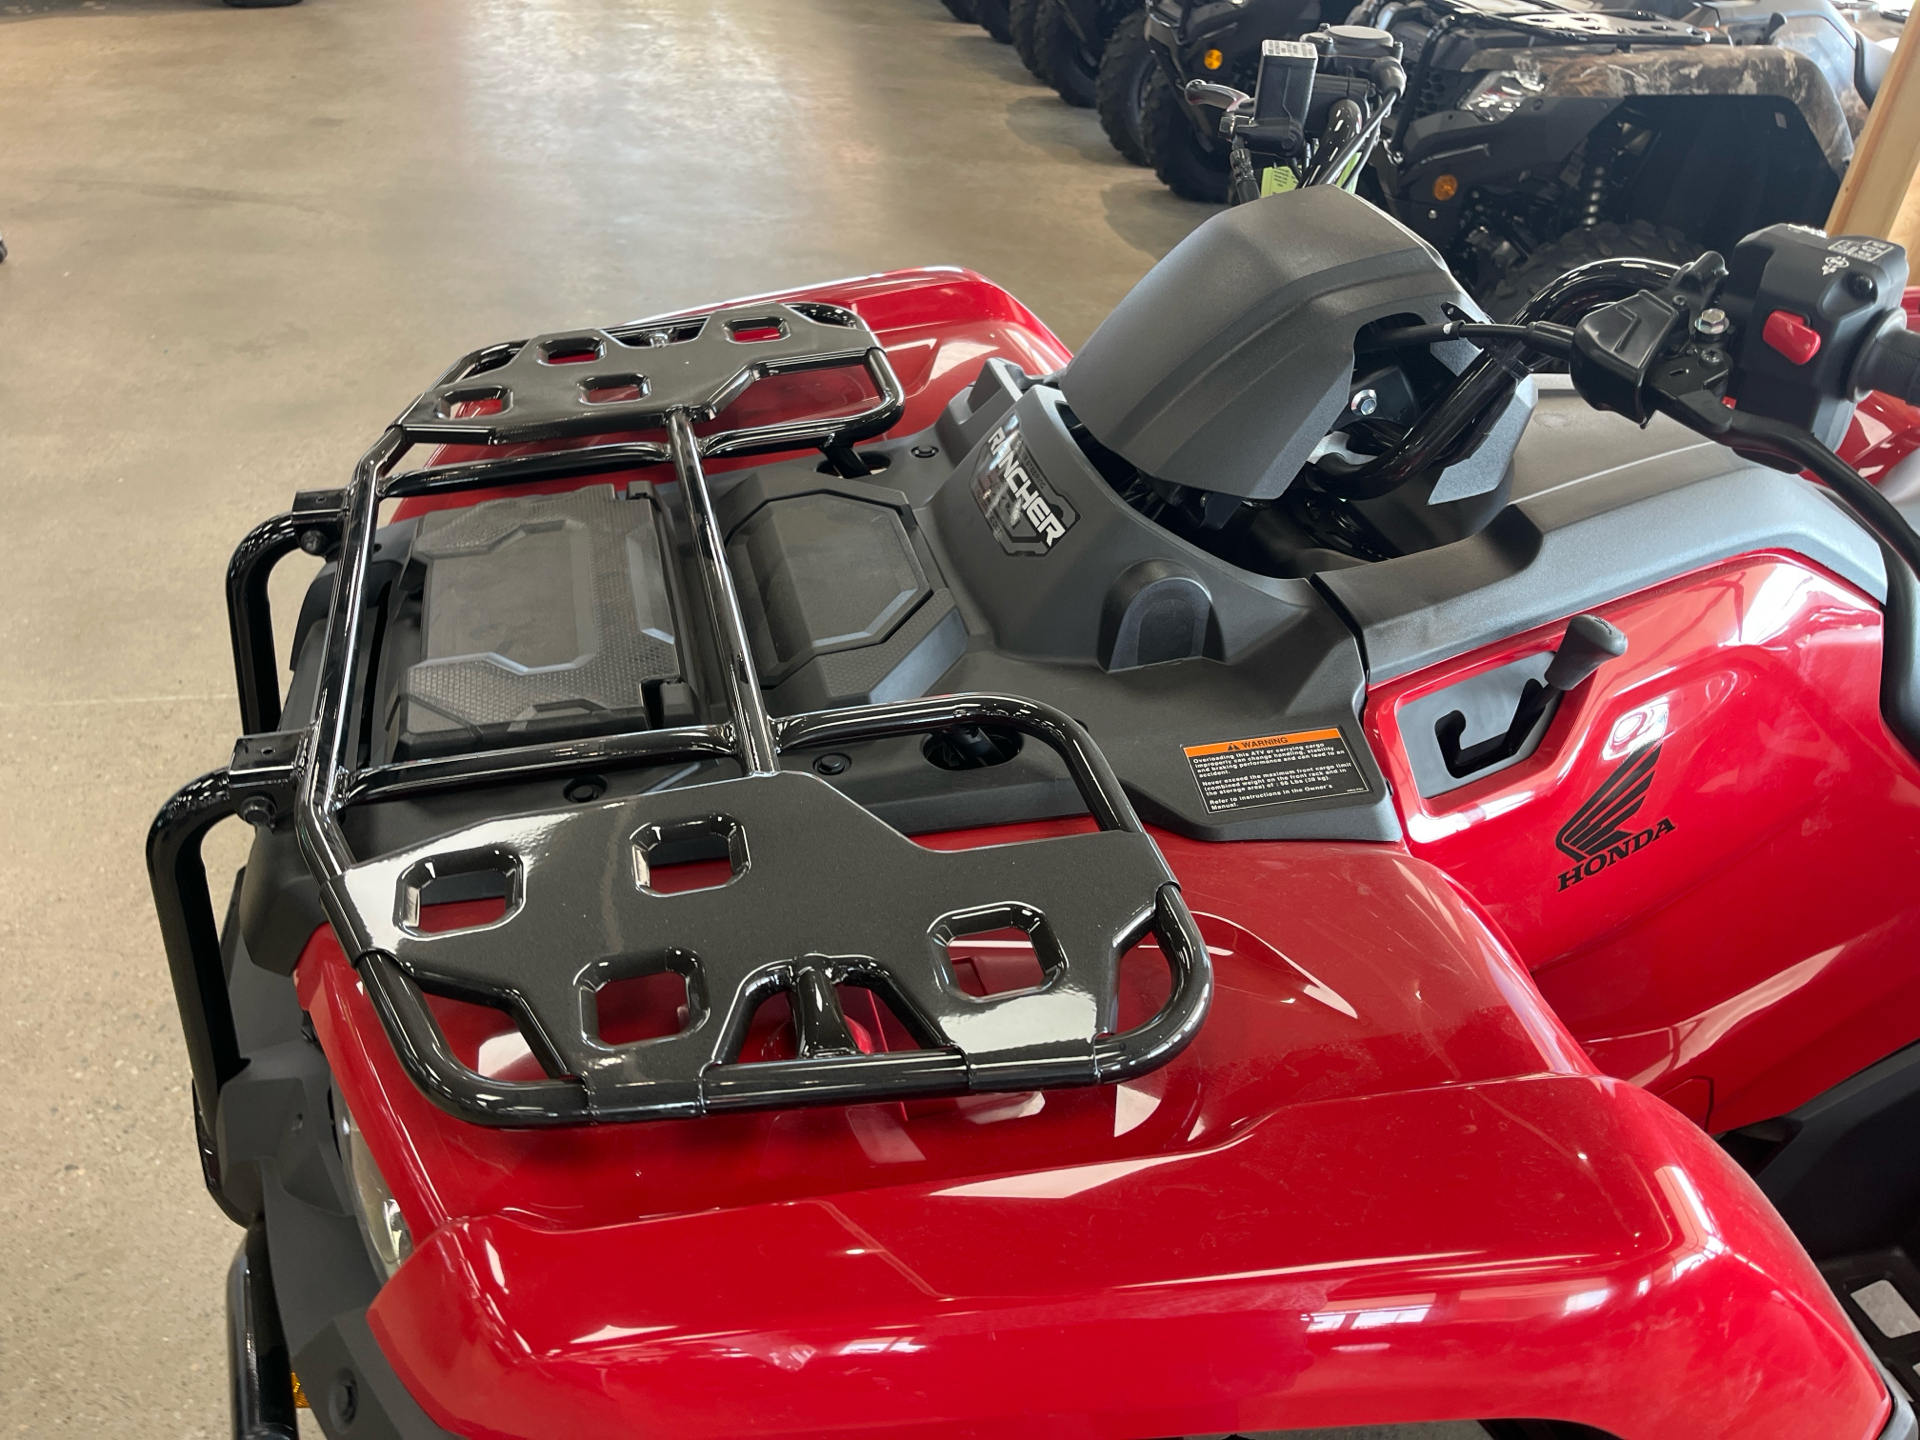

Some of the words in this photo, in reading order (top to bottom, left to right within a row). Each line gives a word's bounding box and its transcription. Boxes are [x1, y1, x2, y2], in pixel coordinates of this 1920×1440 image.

[988, 427, 1066, 547] RANCHER
[1241, 737, 1288, 748] WARNING
[1193, 754, 1234, 764] Overloading
[1195, 760, 1232, 769] improperly
[1307, 746, 1334, 754] stability
[1239, 758, 1282, 768] performance
[1199, 770, 1231, 778] accident.
[1263, 770, 1296, 778] maximum
[1204, 782, 1241, 792] (combined
[1242, 778, 1265, 786] weight
[1219, 787, 1246, 795] storage
[1239, 791, 1282, 801] instructions
[1304, 783, 1333, 792] Owner's
[1211, 803, 1239, 811] Manual.
[1557, 817, 1676, 893] HONDA
